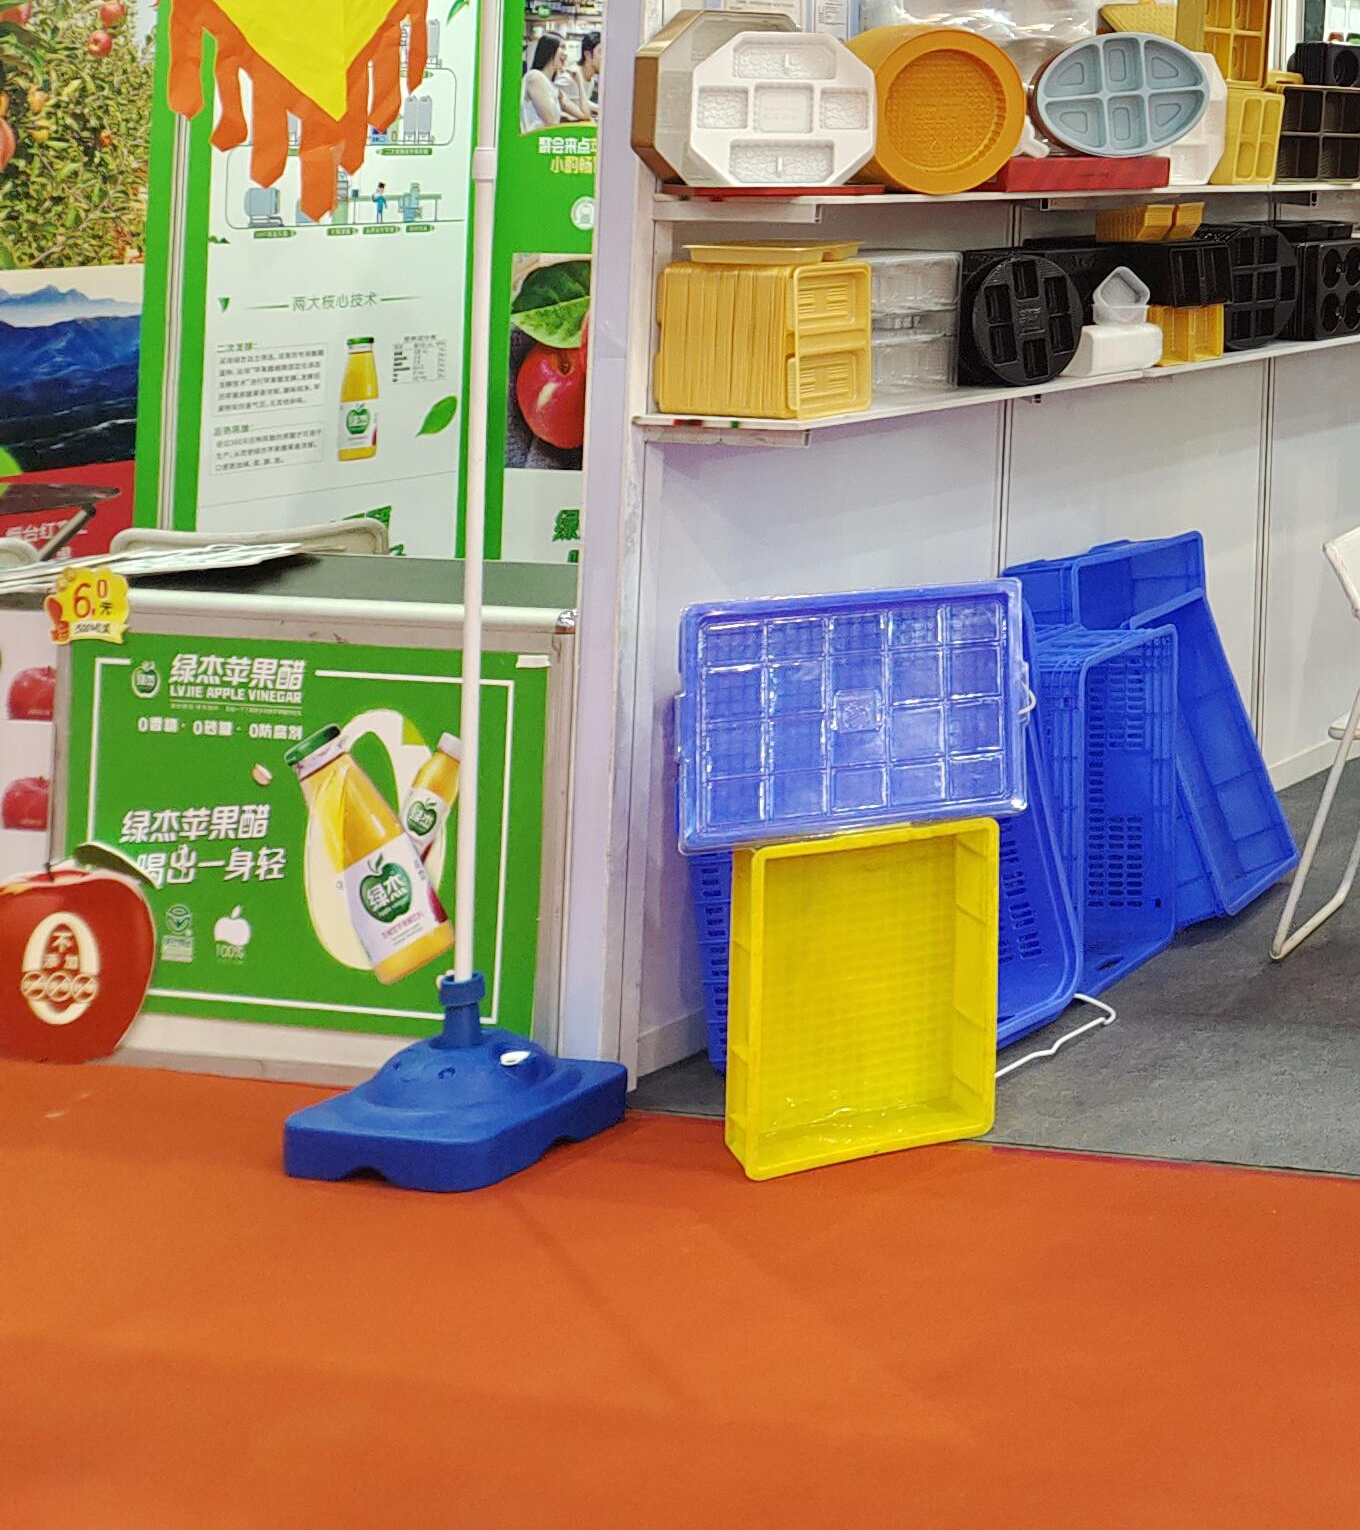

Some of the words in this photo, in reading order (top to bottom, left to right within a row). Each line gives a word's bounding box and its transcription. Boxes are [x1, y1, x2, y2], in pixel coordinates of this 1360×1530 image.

[292, 292, 377, 311] 两大核心技术
[169, 653, 305, 690] 绿杰苹果醋
[170, 684, 203, 698] LVJIE
[206, 687, 245, 701] APPLE
[248, 689, 302, 704] VINEGAR
[119, 804, 270, 843] 绿杰苹果醋
